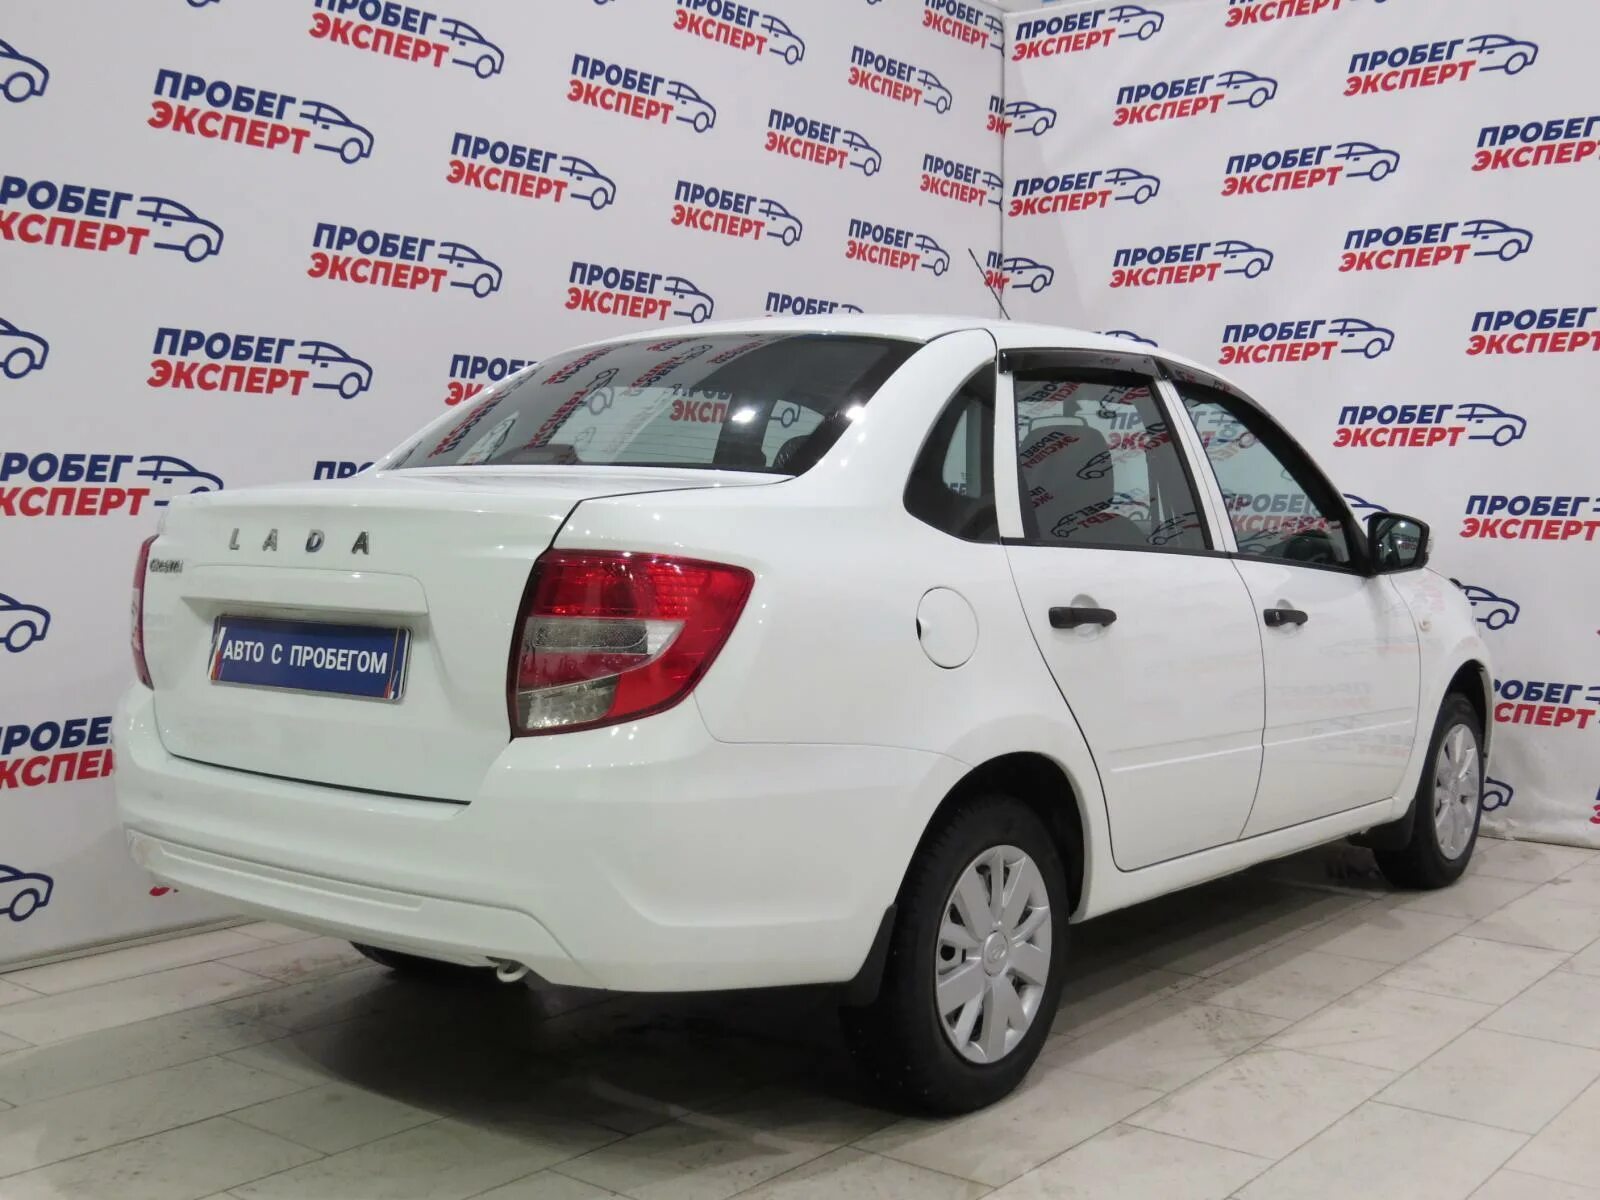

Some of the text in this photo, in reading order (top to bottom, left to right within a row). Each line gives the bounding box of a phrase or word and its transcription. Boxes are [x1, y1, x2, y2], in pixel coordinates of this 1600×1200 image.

[309, 12, 449, 67] ЭКСПЕРТ
[674, 9, 767, 55] ЭКСПЕРТ
[923, 9, 988, 48] ЭКСПЕРТ
[1016, 8, 1105, 41] ПРОБЕГ
[1012, 27, 1116, 61] ЭКСПЕРТ
[1349, 38, 1465, 75] ПРОБЕГ
[572, 54, 665, 97] ПРОБЕГ
[851, 46, 918, 83] ПРОБЕГ
[1344, 59, 1477, 96] ЭКСПЕРТ
[154, 69, 297, 120] ПРОБЕГ
[567, 79, 674, 124] ЭКСПЕРТ
[848, 67, 923, 106] ЭКСПЕРТ
[1117, 74, 1216, 104] ПРОБЕГ
[1113, 93, 1225, 126] ЭКСПЕРТ
[148, 100, 311, 154] ЭКСПЕРТ
[769, 109, 842, 145] ПРОБЕГ
[451, 132, 558, 174] ПРОБЕГ
[765, 131, 849, 169] ЭКСПЕРТ
[1226, 146, 1332, 175] ПРОБЕГ
[1472, 140, 1600, 171] ЭКСПЕР
[447, 160, 569, 203] ЭКСПЕРТ
[923, 154, 981, 186] ПРОБЕГ
[1013, 171, 1103, 197] ПРОБЕГ
[1221, 165, 1343, 196] ЭКСПЕРТ
[675, 180, 757, 216] ПРОБЕГ
[920, 174, 988, 207] ЭКСПЕРТ
[1008, 188, 1113, 217] ЭКСПЕРТ
[671, 203, 766, 246] ЭКСПЕРТ
[849, 218, 914, 249] ПРОБЕГ
[1344, 222, 1459, 250] ПРОБЕГ
[313, 222, 436, 262] ПРОБЕГ
[846, 240, 921, 272] ЭКСПЕРТ
[1114, 242, 1211, 268] ПРОБЕГ
[1339, 243, 1471, 272] ЭКСПЕРТ
[307, 251, 448, 292] ЭКСПЕРТ
[570, 261, 663, 294] ПРОБЕГ
[1110, 262, 1222, 288] ЭКСПЕРТ
[565, 286, 672, 321] ЭКСПЕРТ
[766, 292, 839, 316] ПРОБЕГ
[1472, 306, 1598, 332] ПРОБЕГ
[153, 327, 296, 365] ПРОБЕГ
[1223, 319, 1326, 344] ПРОБЕГ
[1218, 340, 1339, 365] ЭКСПЕРТ
[147, 358, 310, 396] ЭКСПЕРТ
[1339, 404, 1454, 426] ПРОБЕГ
[1332, 425, 1467, 447] ЭКСПЕРТ
[1466, 495, 1590, 516] ПРОБЕГ
[229, 527, 370, 555] LADA
[223, 639, 264, 662] АВТО
[289, 644, 388, 674] ПРОБЕГОМ
[0, 716, 113, 755] РОБЕ
